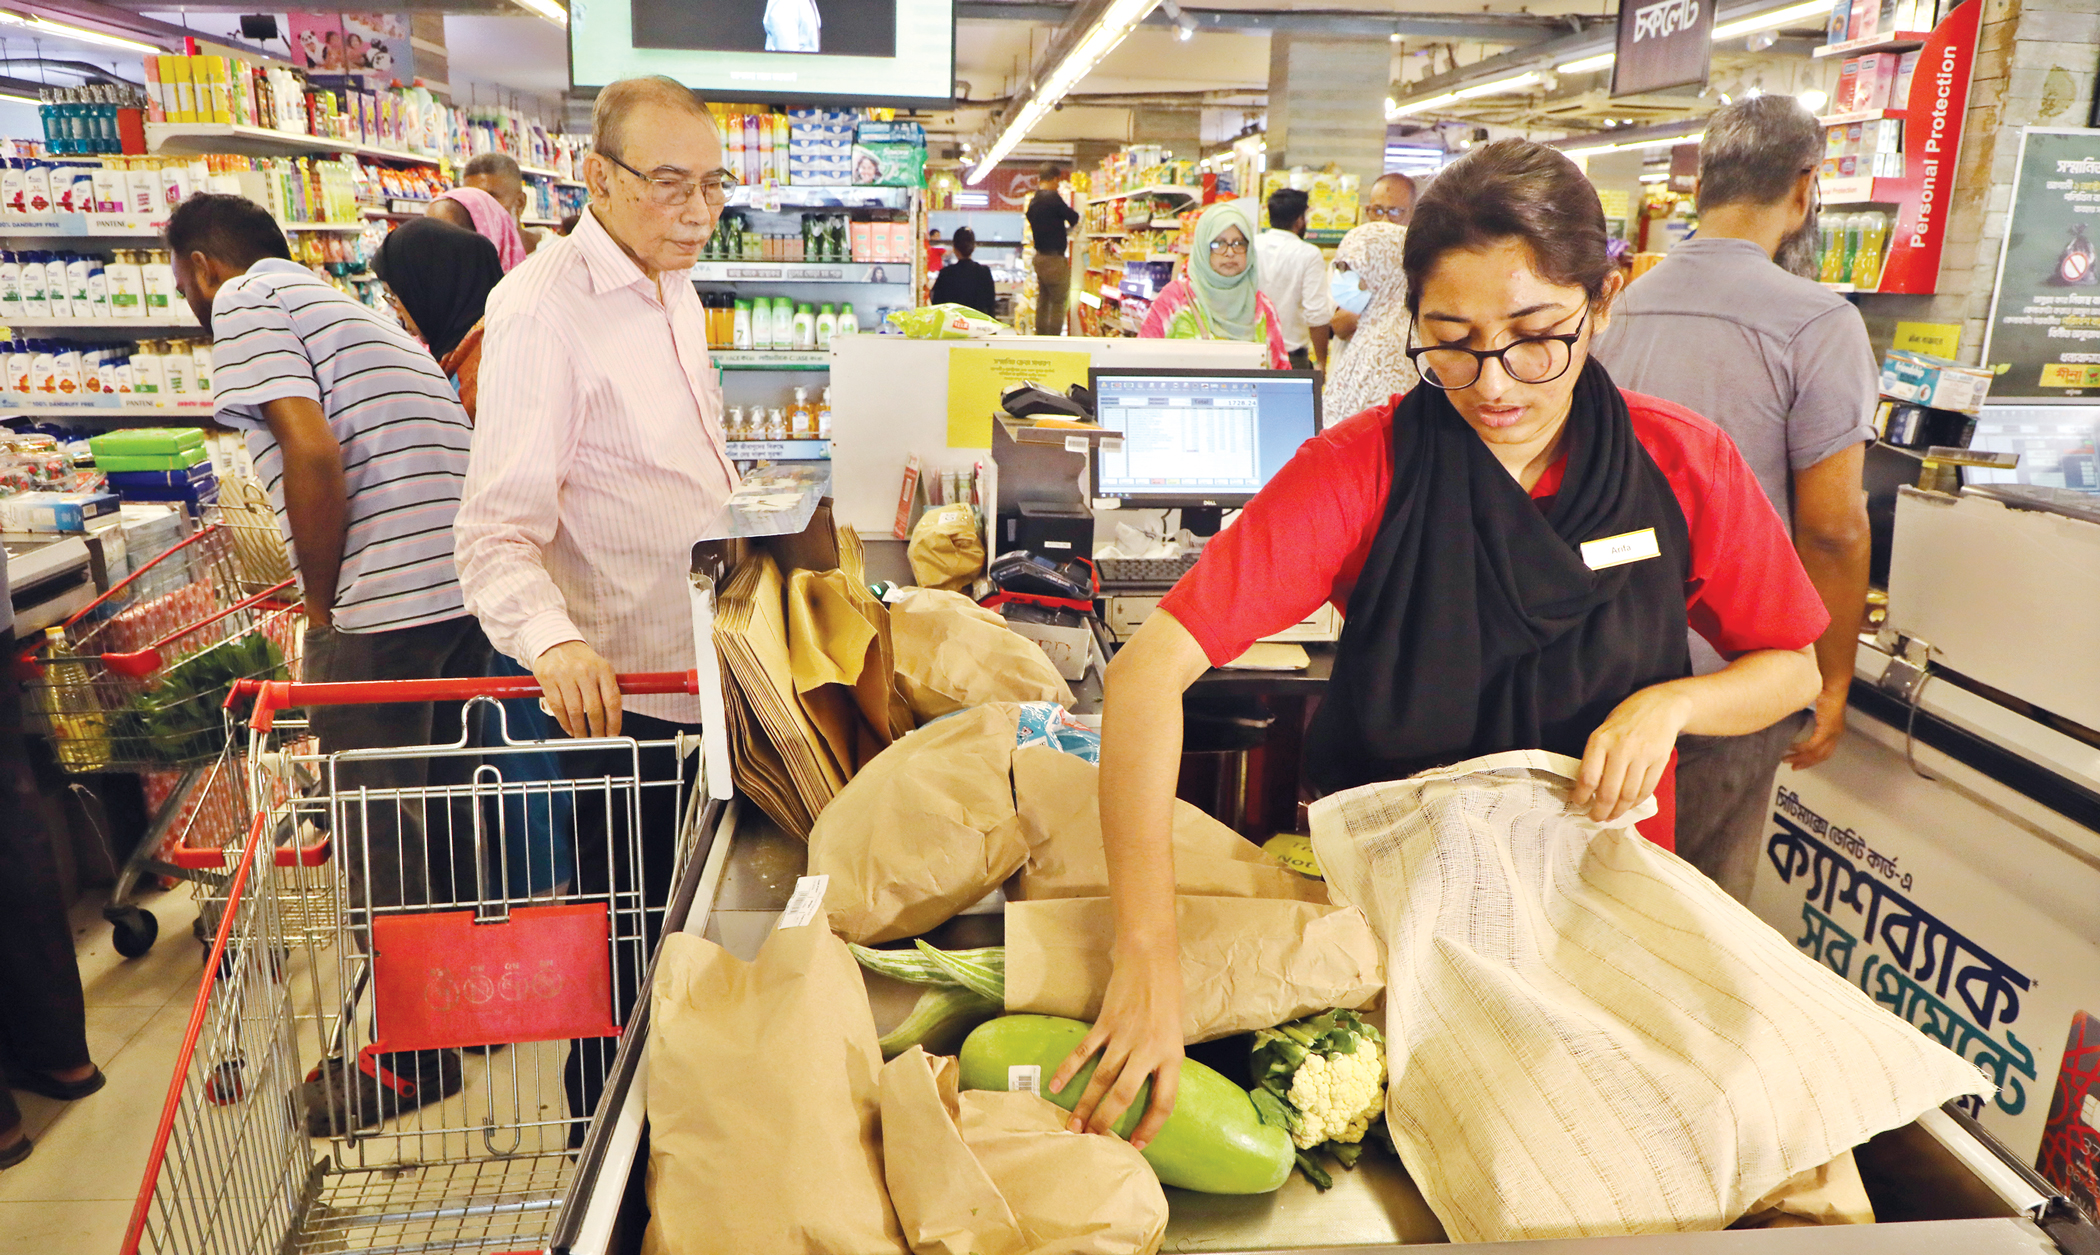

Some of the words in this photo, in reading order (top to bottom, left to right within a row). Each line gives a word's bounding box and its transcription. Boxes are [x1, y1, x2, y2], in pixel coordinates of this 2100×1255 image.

[1909, 158, 1939, 248] Personal
[1924, 45, 1957, 153] Protection
[1829, 828, 1867, 860] ডেবিট
[1866, 849, 1913, 892] কার্ড-এ
[1797, 901, 1858, 979] সব
